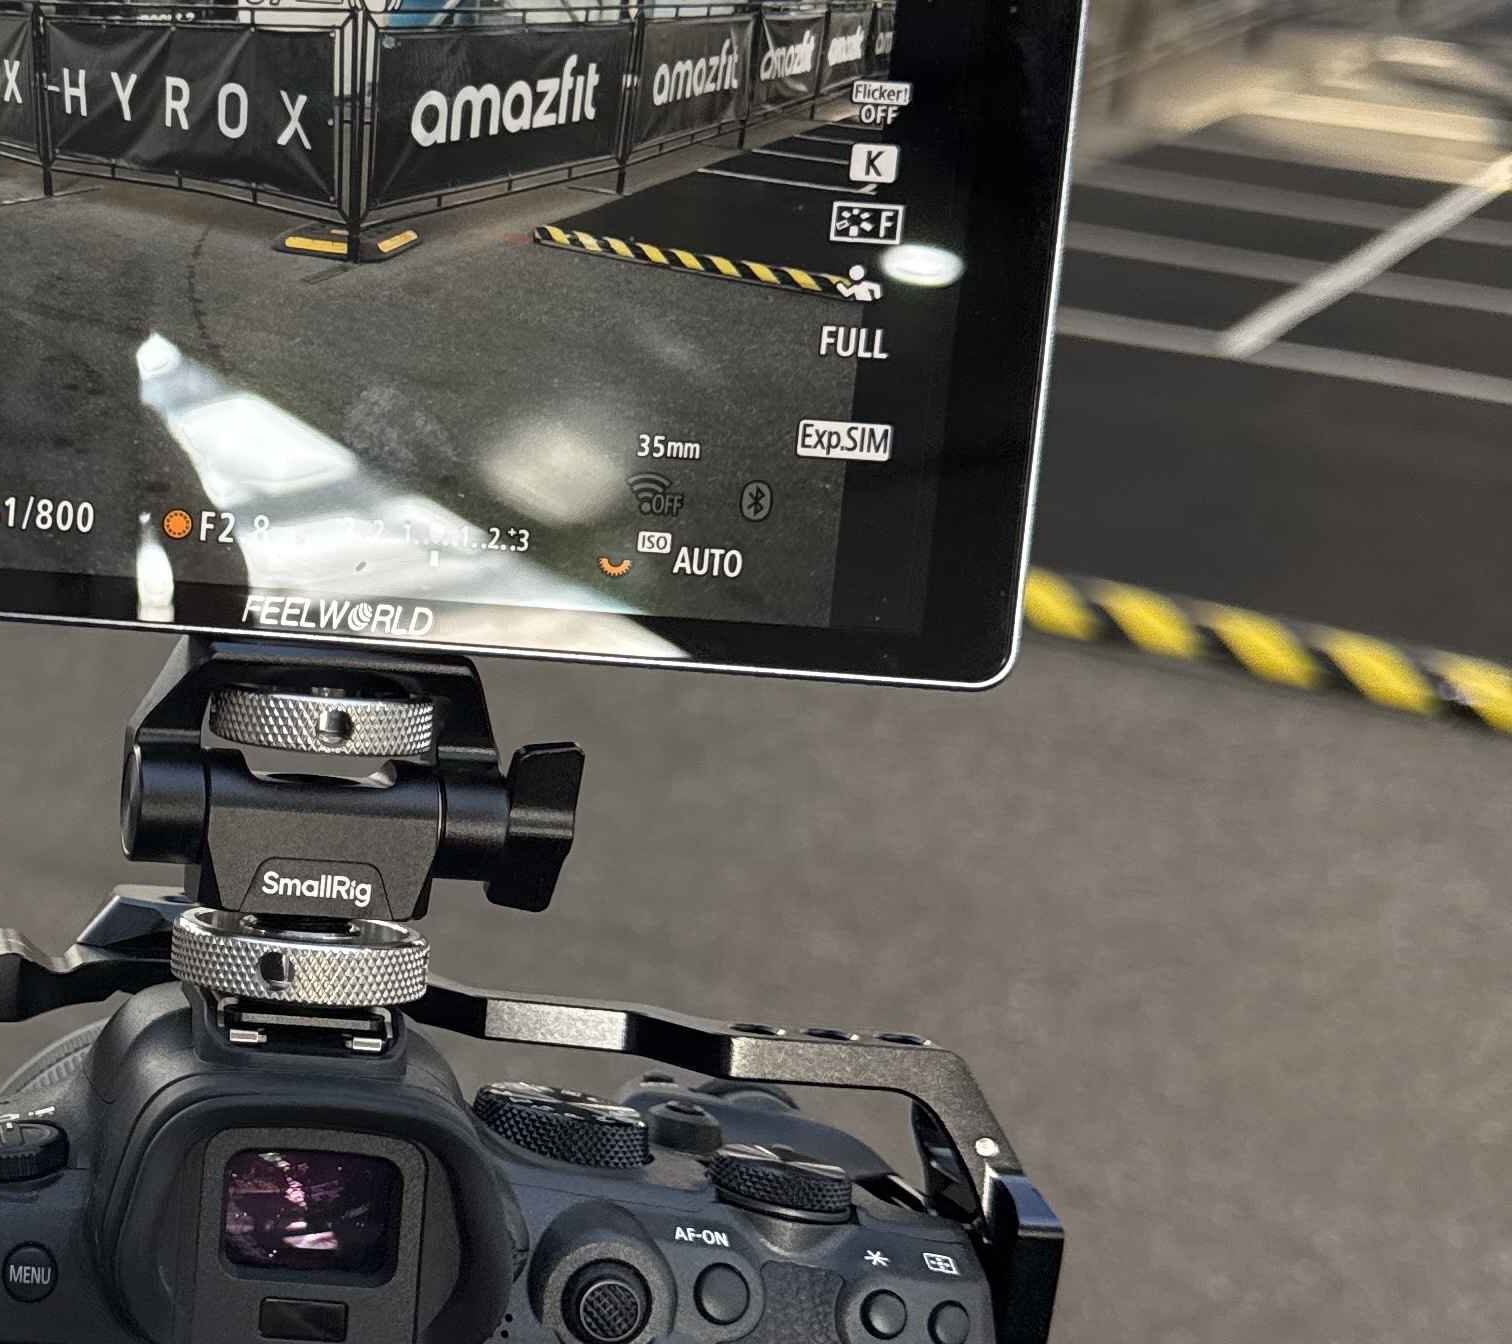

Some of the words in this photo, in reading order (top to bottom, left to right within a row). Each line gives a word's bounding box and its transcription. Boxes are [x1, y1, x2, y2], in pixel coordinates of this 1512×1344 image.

[652, 38, 739, 107] amazfit
[63, 67, 312, 151] HYROX
[410, 53, 600, 148] amazfit
[860, 105, 899, 125] OFF
[819, 325, 888, 360] FULL
[637, 434, 701, 461] 35mm
[3, 496, 95, 533] 1/800
[199, 510, 270, 544] F28
[640, 534, 669, 552] ISO
[673, 548, 743, 579] AUTO
[242, 594, 434, 637] FEELWORLD
[261, 871, 373, 908] SmallRig
[674, 1226, 729, 1248] AF-ON
[9, 1264, 52, 1285] MENU
